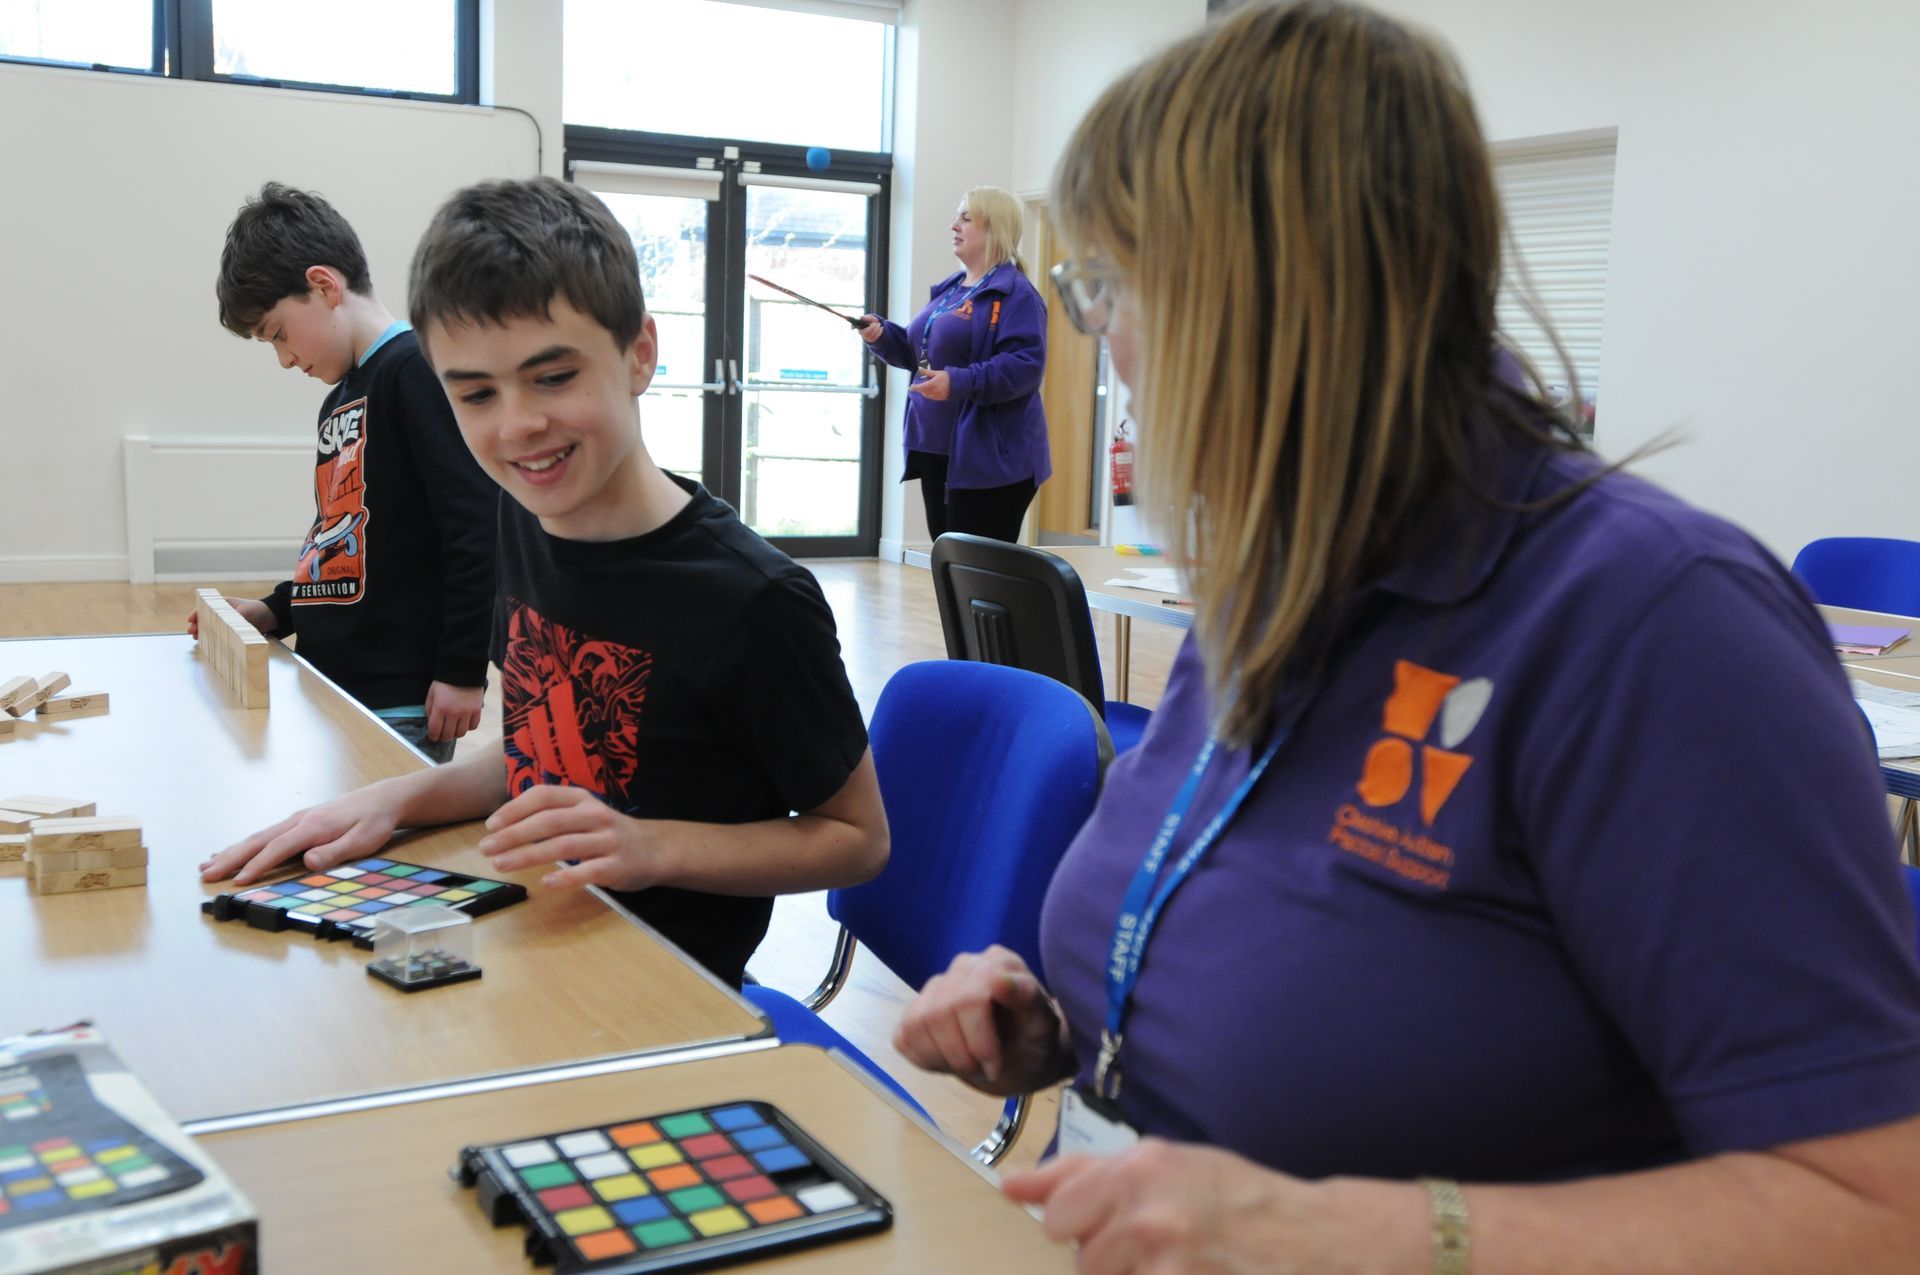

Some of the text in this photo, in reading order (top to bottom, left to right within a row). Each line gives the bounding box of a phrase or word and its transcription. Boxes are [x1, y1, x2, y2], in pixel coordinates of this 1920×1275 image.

[301, 582, 356, 597] GENERATION
[327, 565, 355, 576] ORIGINAL
[1144, 813, 1181, 875] STAFF
[1109, 912, 1138, 984] STAFF
